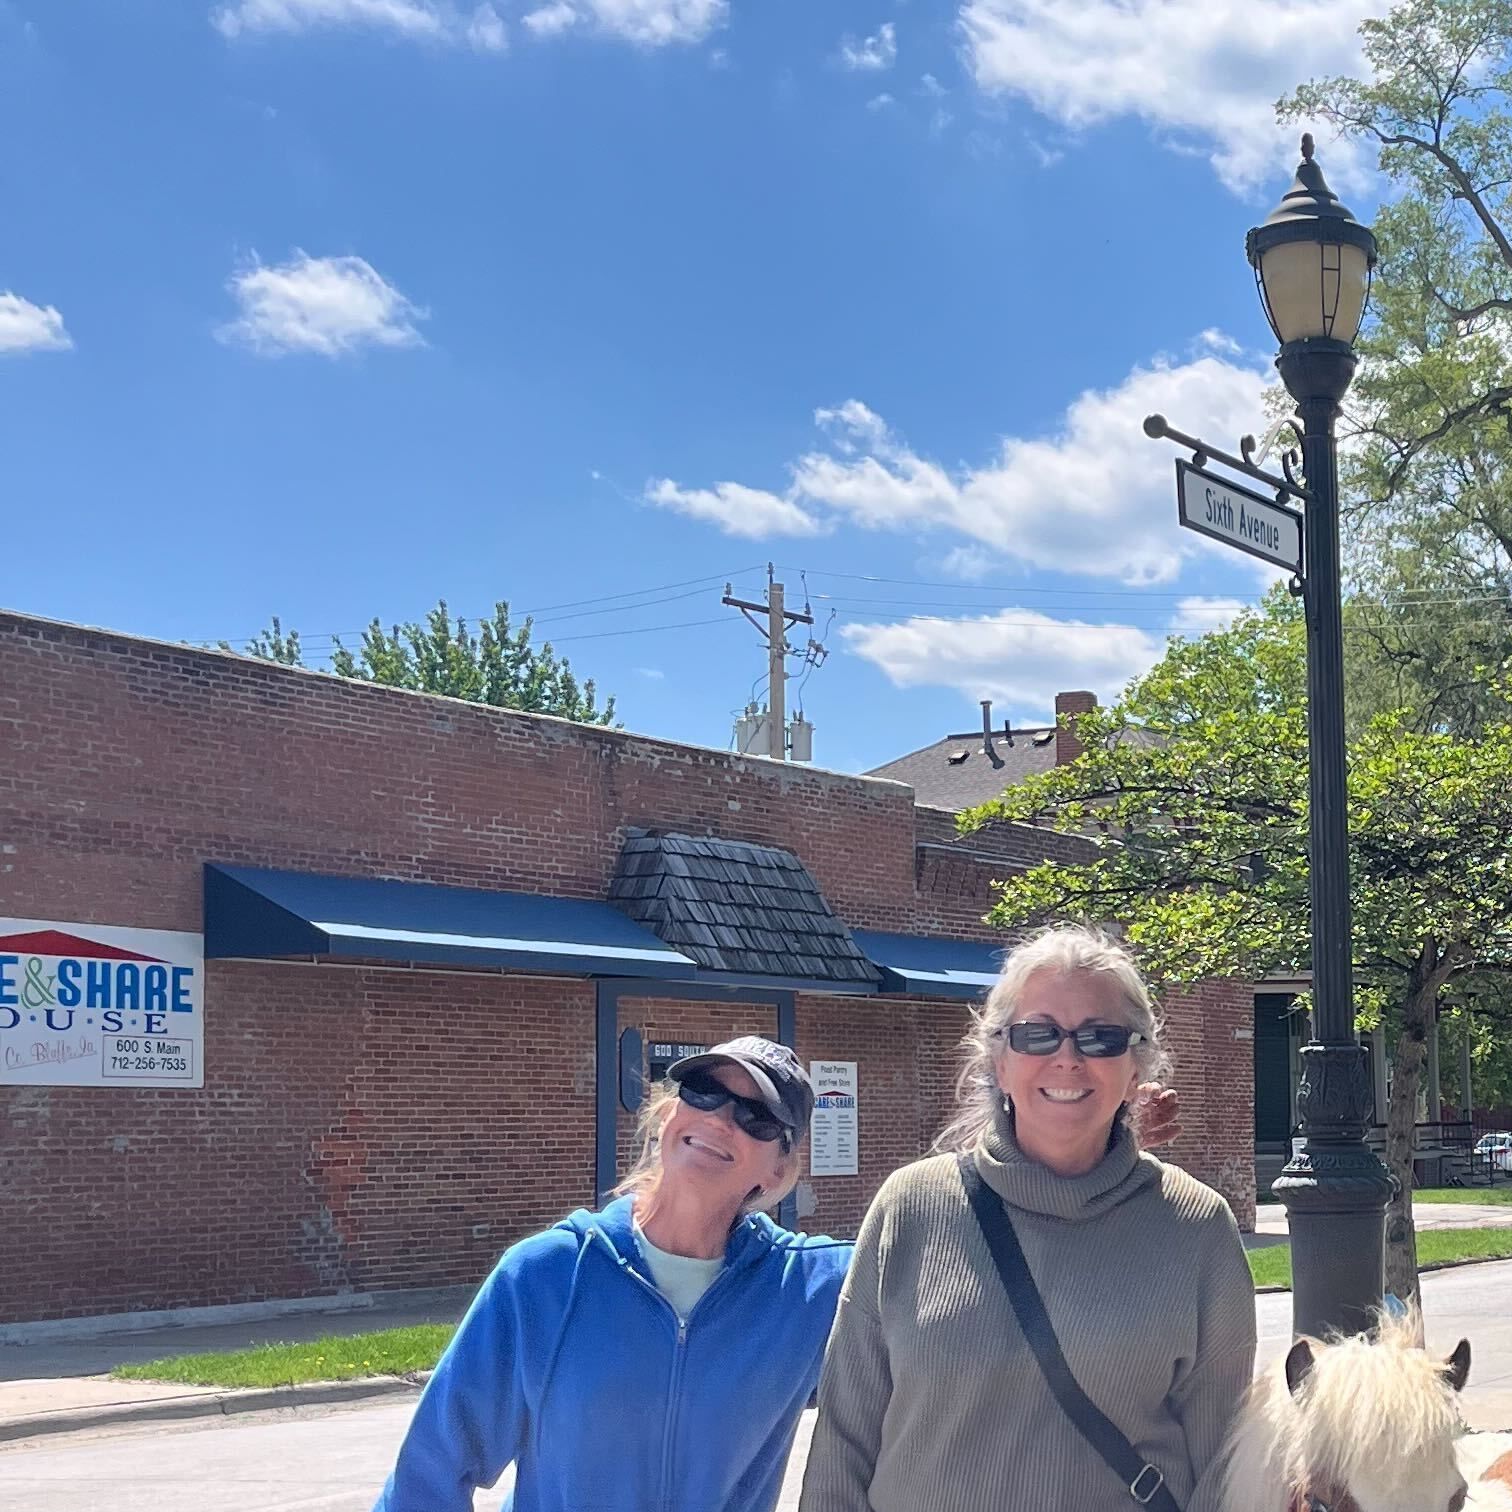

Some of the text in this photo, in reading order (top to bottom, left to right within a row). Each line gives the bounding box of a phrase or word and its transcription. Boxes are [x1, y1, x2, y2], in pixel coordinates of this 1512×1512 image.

[1205, 487, 1280, 551] Sixth Avenue
[116, 1039, 139, 1053] 600
[157, 1041, 181, 1055] Main
[654, 1044, 672, 1057] 600
[111, 1056, 187, 1071] 712-256-7535
